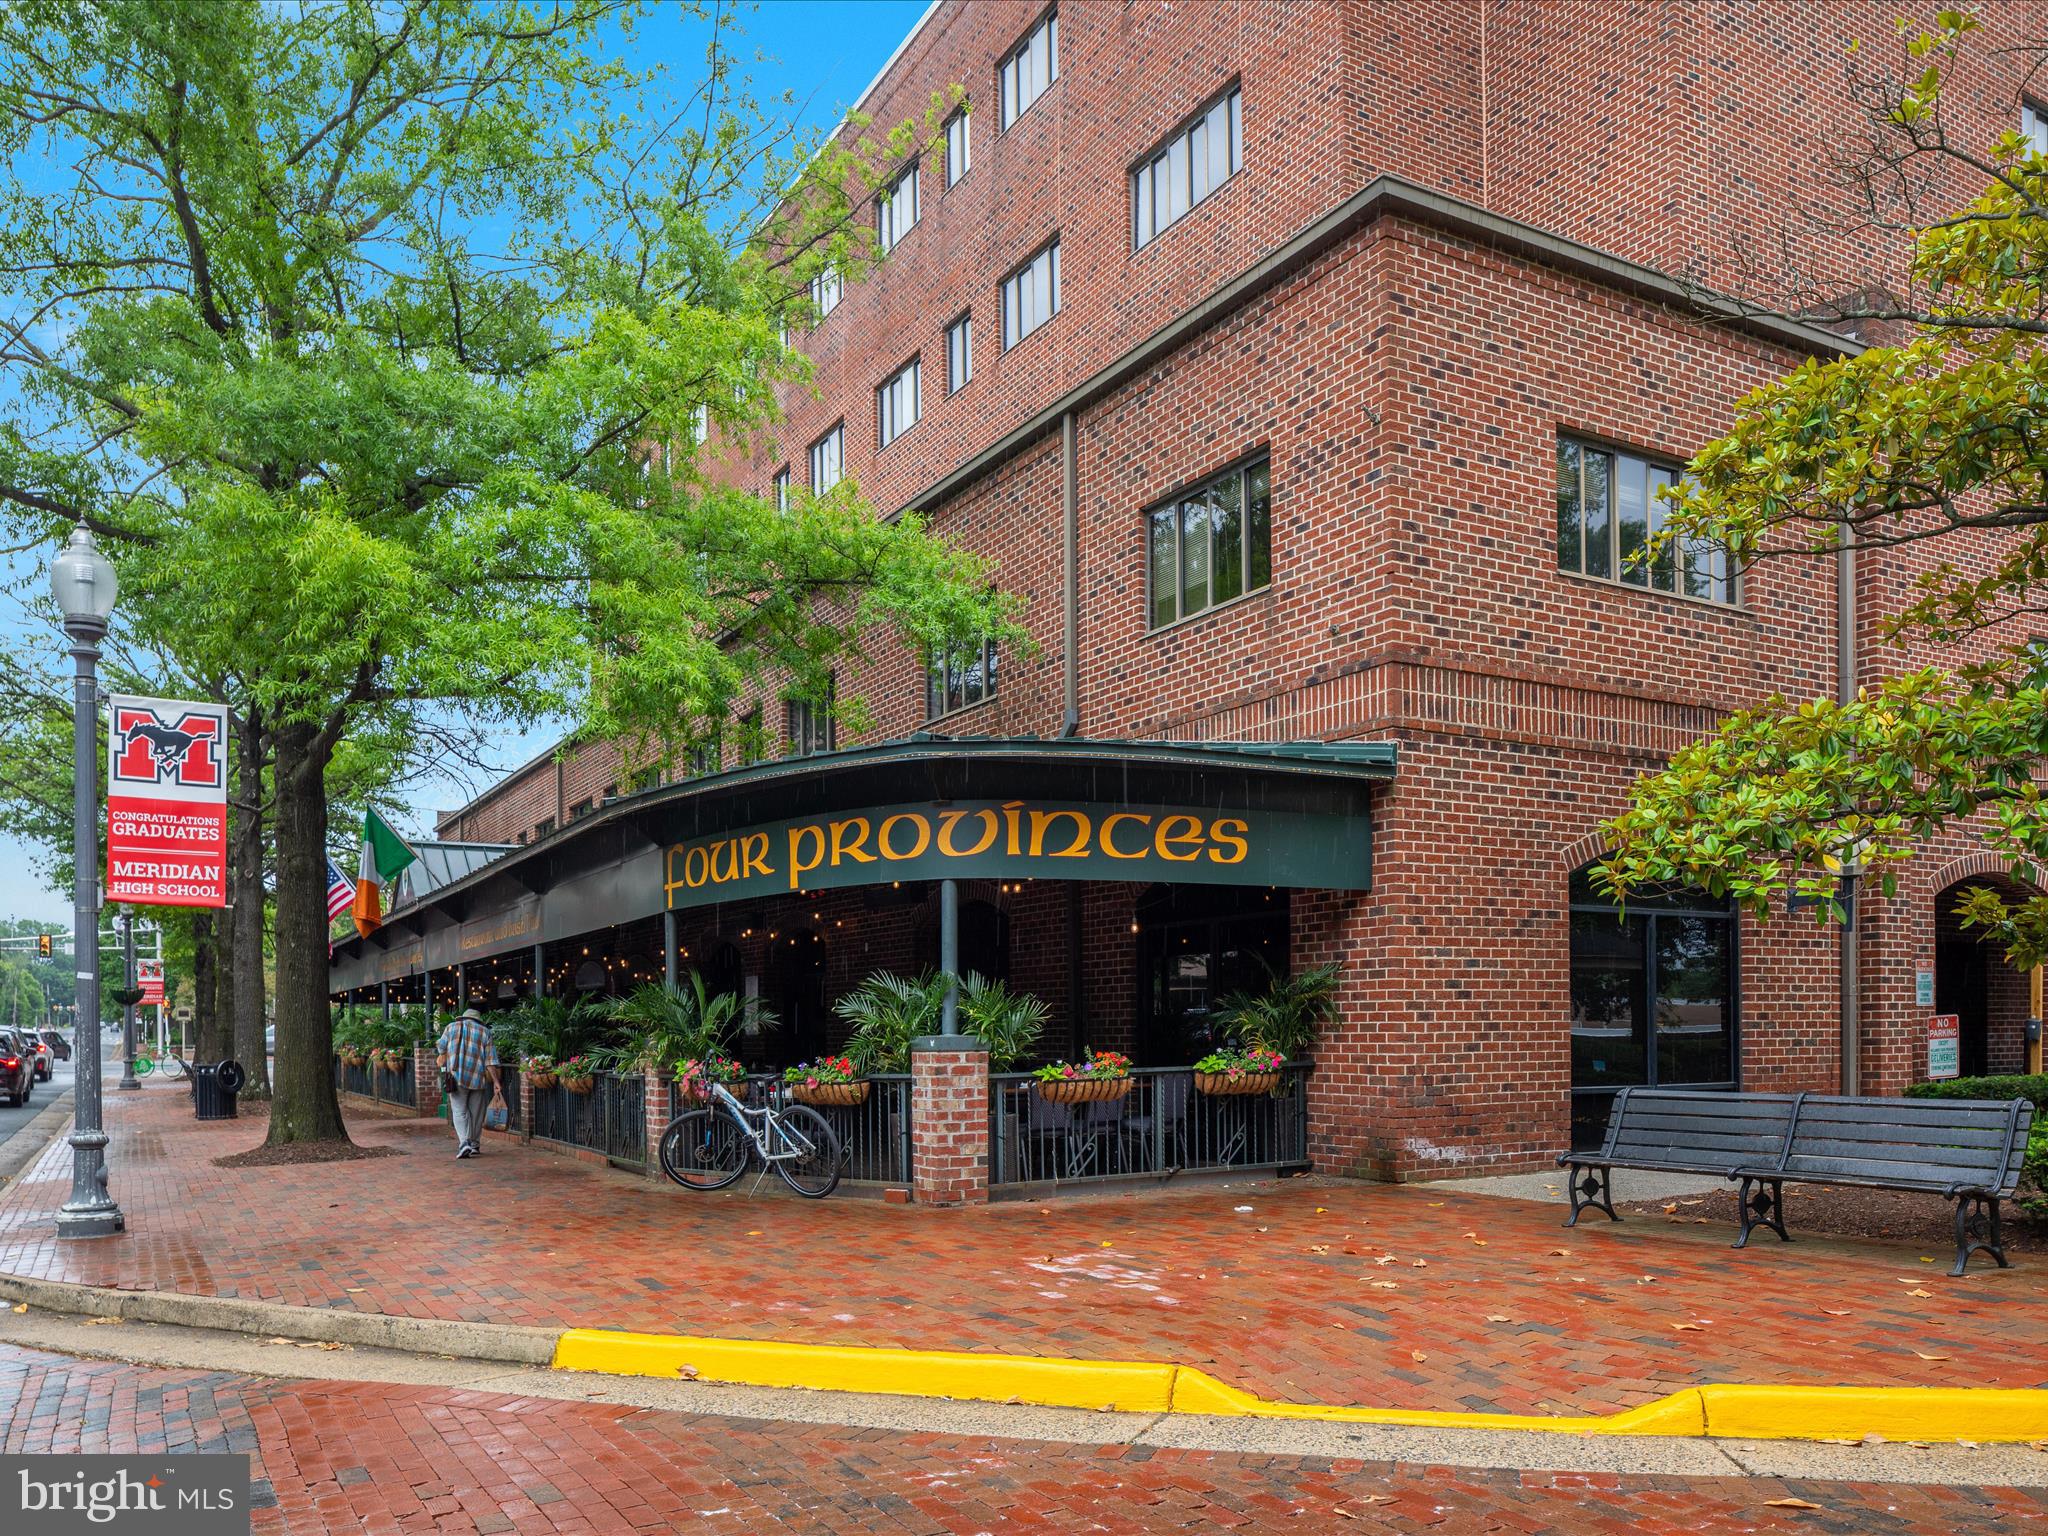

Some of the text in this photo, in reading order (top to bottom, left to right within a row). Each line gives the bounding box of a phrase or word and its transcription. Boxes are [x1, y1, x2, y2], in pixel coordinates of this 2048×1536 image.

[112, 811, 220, 826] CONGRATULATIONS
[112, 822, 220, 841] GRADUATES
[112, 860, 220, 881] MERIDIAN
[112, 881, 220, 897] HIGH SCHOOL
[1937, 1018, 1949, 1028] NO
[1929, 1028, 1957, 1038] PARKING
